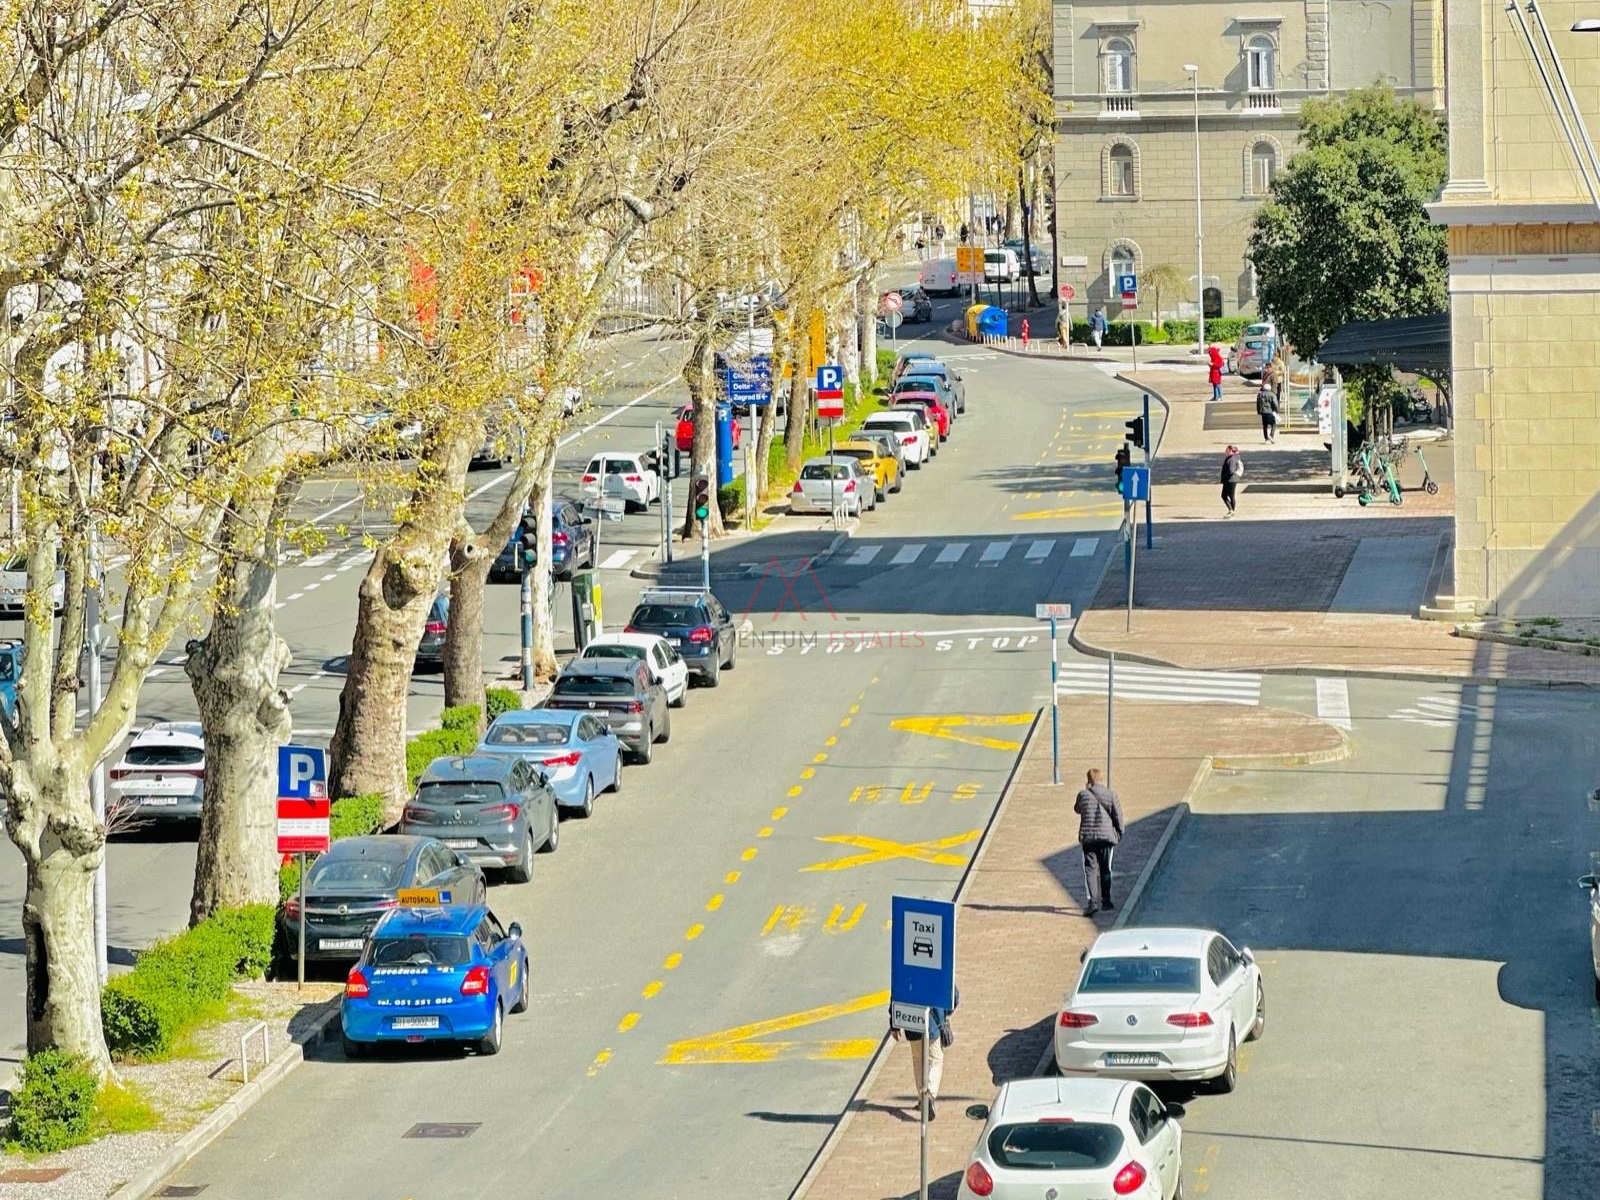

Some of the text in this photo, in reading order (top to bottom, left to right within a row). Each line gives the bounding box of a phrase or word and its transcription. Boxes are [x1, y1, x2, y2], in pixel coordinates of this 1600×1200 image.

[1123, 277, 1134, 290] P
[822, 368, 837, 388] P
[718, 409, 728, 421] P
[766, 642, 877, 656] STOP
[935, 635, 1040, 652] STOP
[289, 752, 316, 791] P
[401, 895, 437, 905] AUTOŠKOLA
[912, 920, 936, 934] Taxi
[414, 998, 431, 1006] 551
